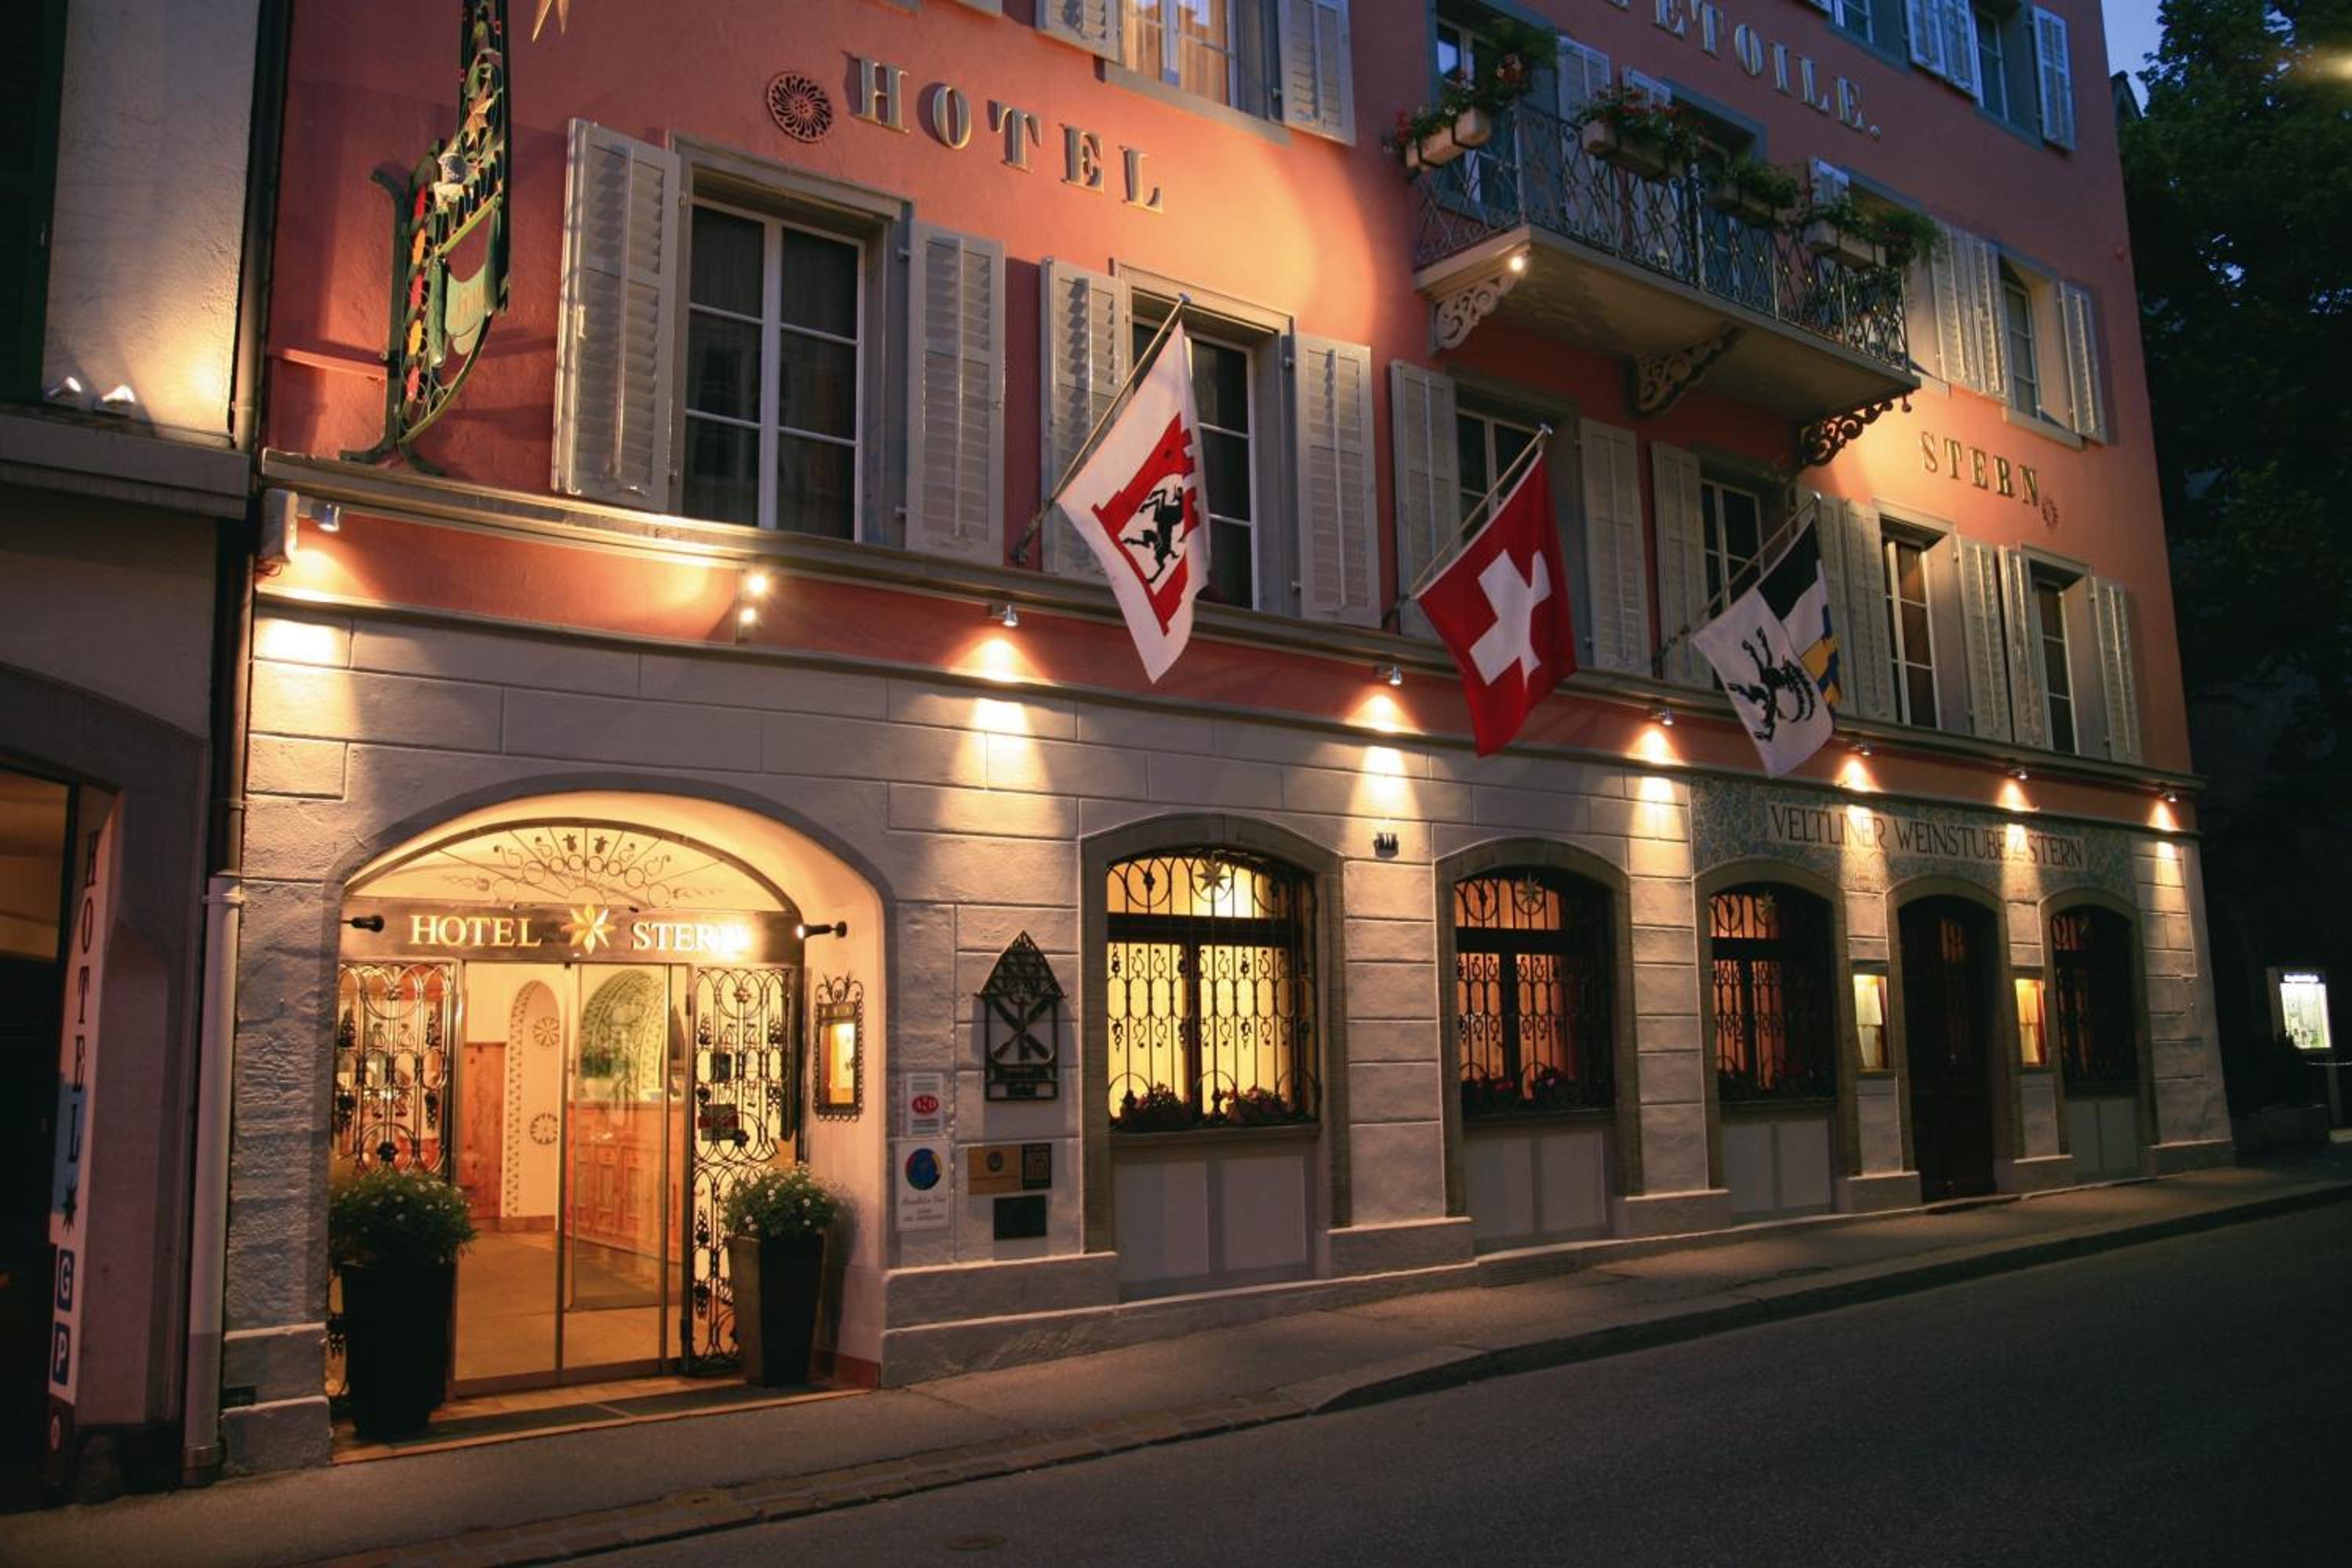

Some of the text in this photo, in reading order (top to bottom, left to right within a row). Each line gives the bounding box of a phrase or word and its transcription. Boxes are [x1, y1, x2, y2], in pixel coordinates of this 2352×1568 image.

[854, 56, 1163, 213] HOTEL
[1920, 430, 2039, 507] STERN
[1769, 804, 1887, 850] VELTLINER
[1893, 818, 2009, 862] WEINSTUBE
[2027, 833, 2083, 866] STERN
[409, 914, 543, 949] HOTEL
[67, 831, 99, 1163] HOTEL
[60, 1255, 72, 1301] G
[55, 1330, 68, 1374] P
